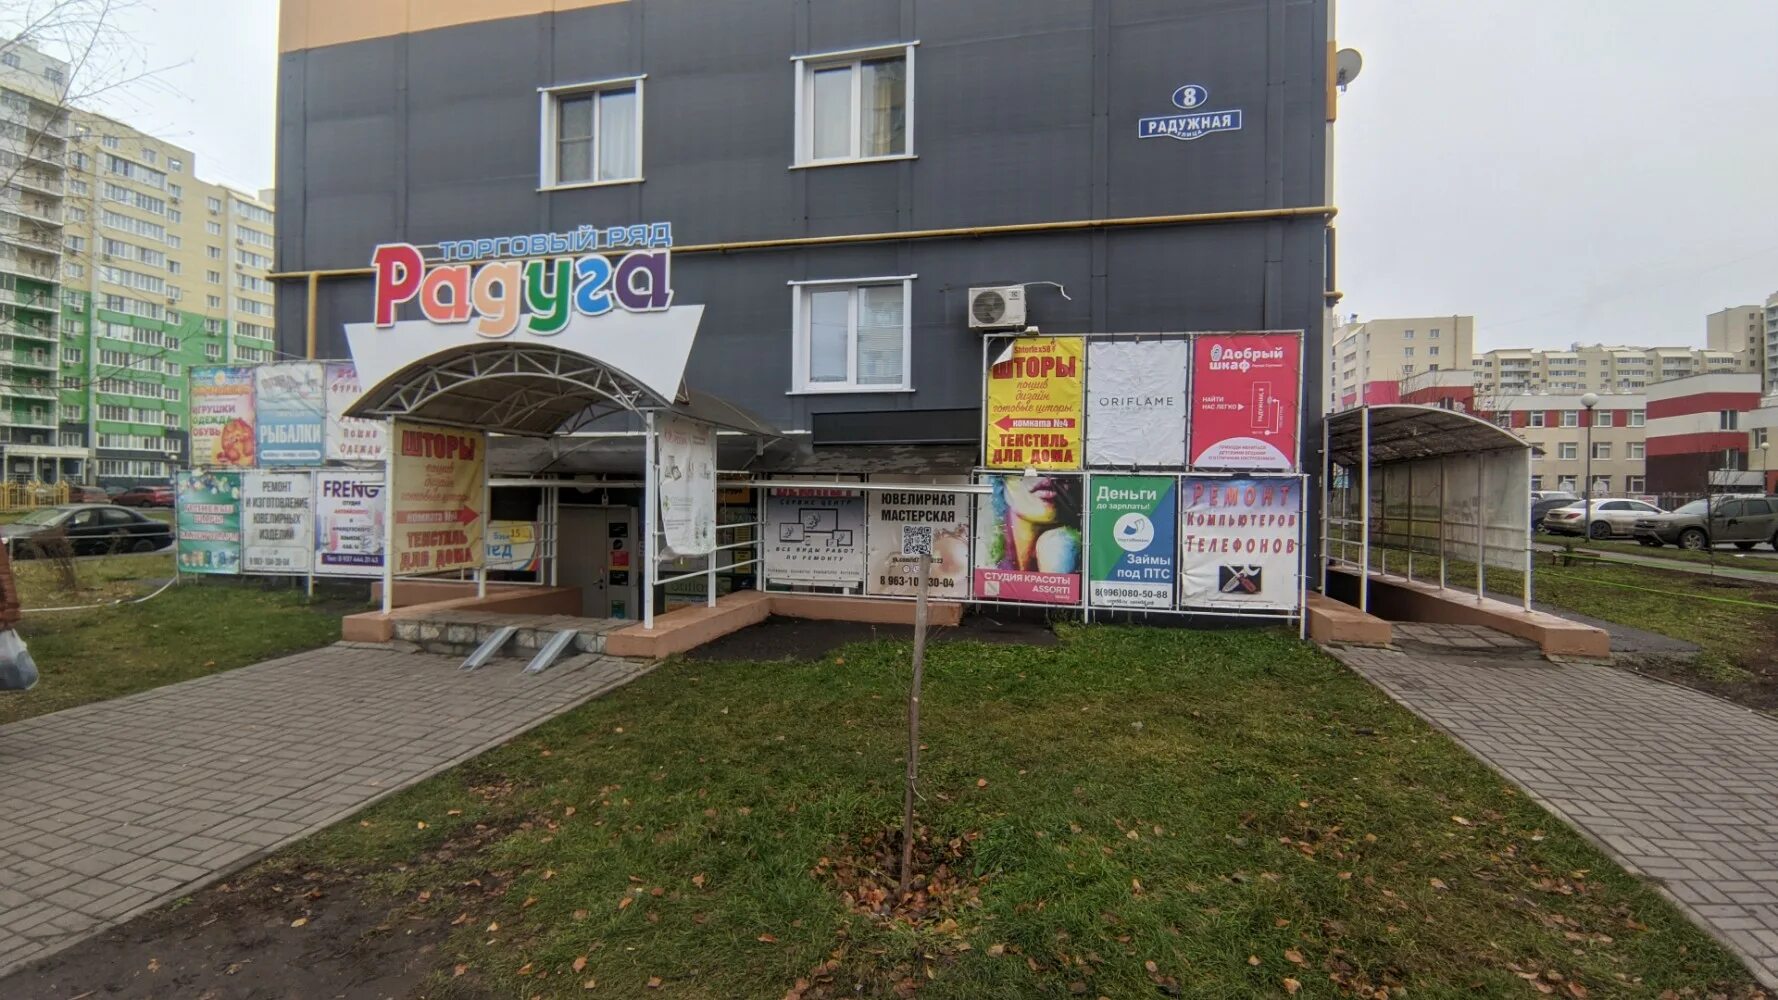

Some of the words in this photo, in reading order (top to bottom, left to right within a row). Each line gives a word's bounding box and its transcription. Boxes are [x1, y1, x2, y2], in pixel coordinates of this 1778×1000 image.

[1183, 87, 1197, 107] 8
[1148, 114, 1232, 134] РАДУЖНАЯ
[439, 225, 597, 261] ТОРГОВЫЙ
[607, 222, 672, 249] РЯД
[372, 242, 674, 338] Радуга
[1222, 347, 1284, 362] Добрый
[992, 356, 1076, 379] ШТОРЫ
[1208, 360, 1251, 373] шкаф
[1016, 379, 1048, 390] пошив
[1099, 396, 1174, 407] ORIFLAME
[192, 404, 236, 414] ИГРУШКИ
[1012, 419, 1051, 428] комната
[1053, 418, 1069, 428] №4
[192, 428, 221, 437] ОБУВЬ
[259, 424, 321, 444] РЫБАЛКИ
[401, 430, 476, 461] ШТОРЫ
[999, 433, 1069, 447] ТЕКСТИЛЬ
[339, 444, 382, 456] ОДЕЖДЫ
[992, 449, 1023, 464] ДЛЯ
[1030, 449, 1074, 464] ДОМА
[262, 481, 292, 493] РЕМОНТ
[323, 480, 380, 498] FRENG
[881, 492, 956, 505] ЮВЕЛИРНАЯ
[1096, 486, 1157, 502] Деньги
[1192, 483, 1290, 507] РЕМОНТ
[245, 498, 250, 508] И
[252, 498, 309, 509] ИЗГОТОВЛЕНИЕ
[1108, 503, 1150, 511] зарплаты!
[253, 513, 301, 524] ЮВЕЛИРНЫХ
[881, 510, 956, 523] МАСТЕРСКАЯ
[1186, 512, 1296, 528] КОМПЬЮТЕРОВ
[259, 528, 295, 540] ИЗДЕЛИЙ
[406, 530, 468, 549] ТЕКСТИЛЬ
[1186, 534, 1295, 554] ТЕЛЕФОНОВ
[400, 551, 429, 570] ДЛЯ
[435, 548, 474, 568] ДОМА
[1127, 553, 1171, 566] Займы
[880, 575, 886, 585] 8
[984, 571, 1023, 582] СТУДИЯ
[1023, 574, 1071, 586] КРАСОТЫ
[1117, 568, 1141, 580] под
[1144, 568, 1170, 580] ПТС
[1032, 585, 1070, 595] ASSORTI
[1095, 588, 1168, 599] 8(996)080-50-88
